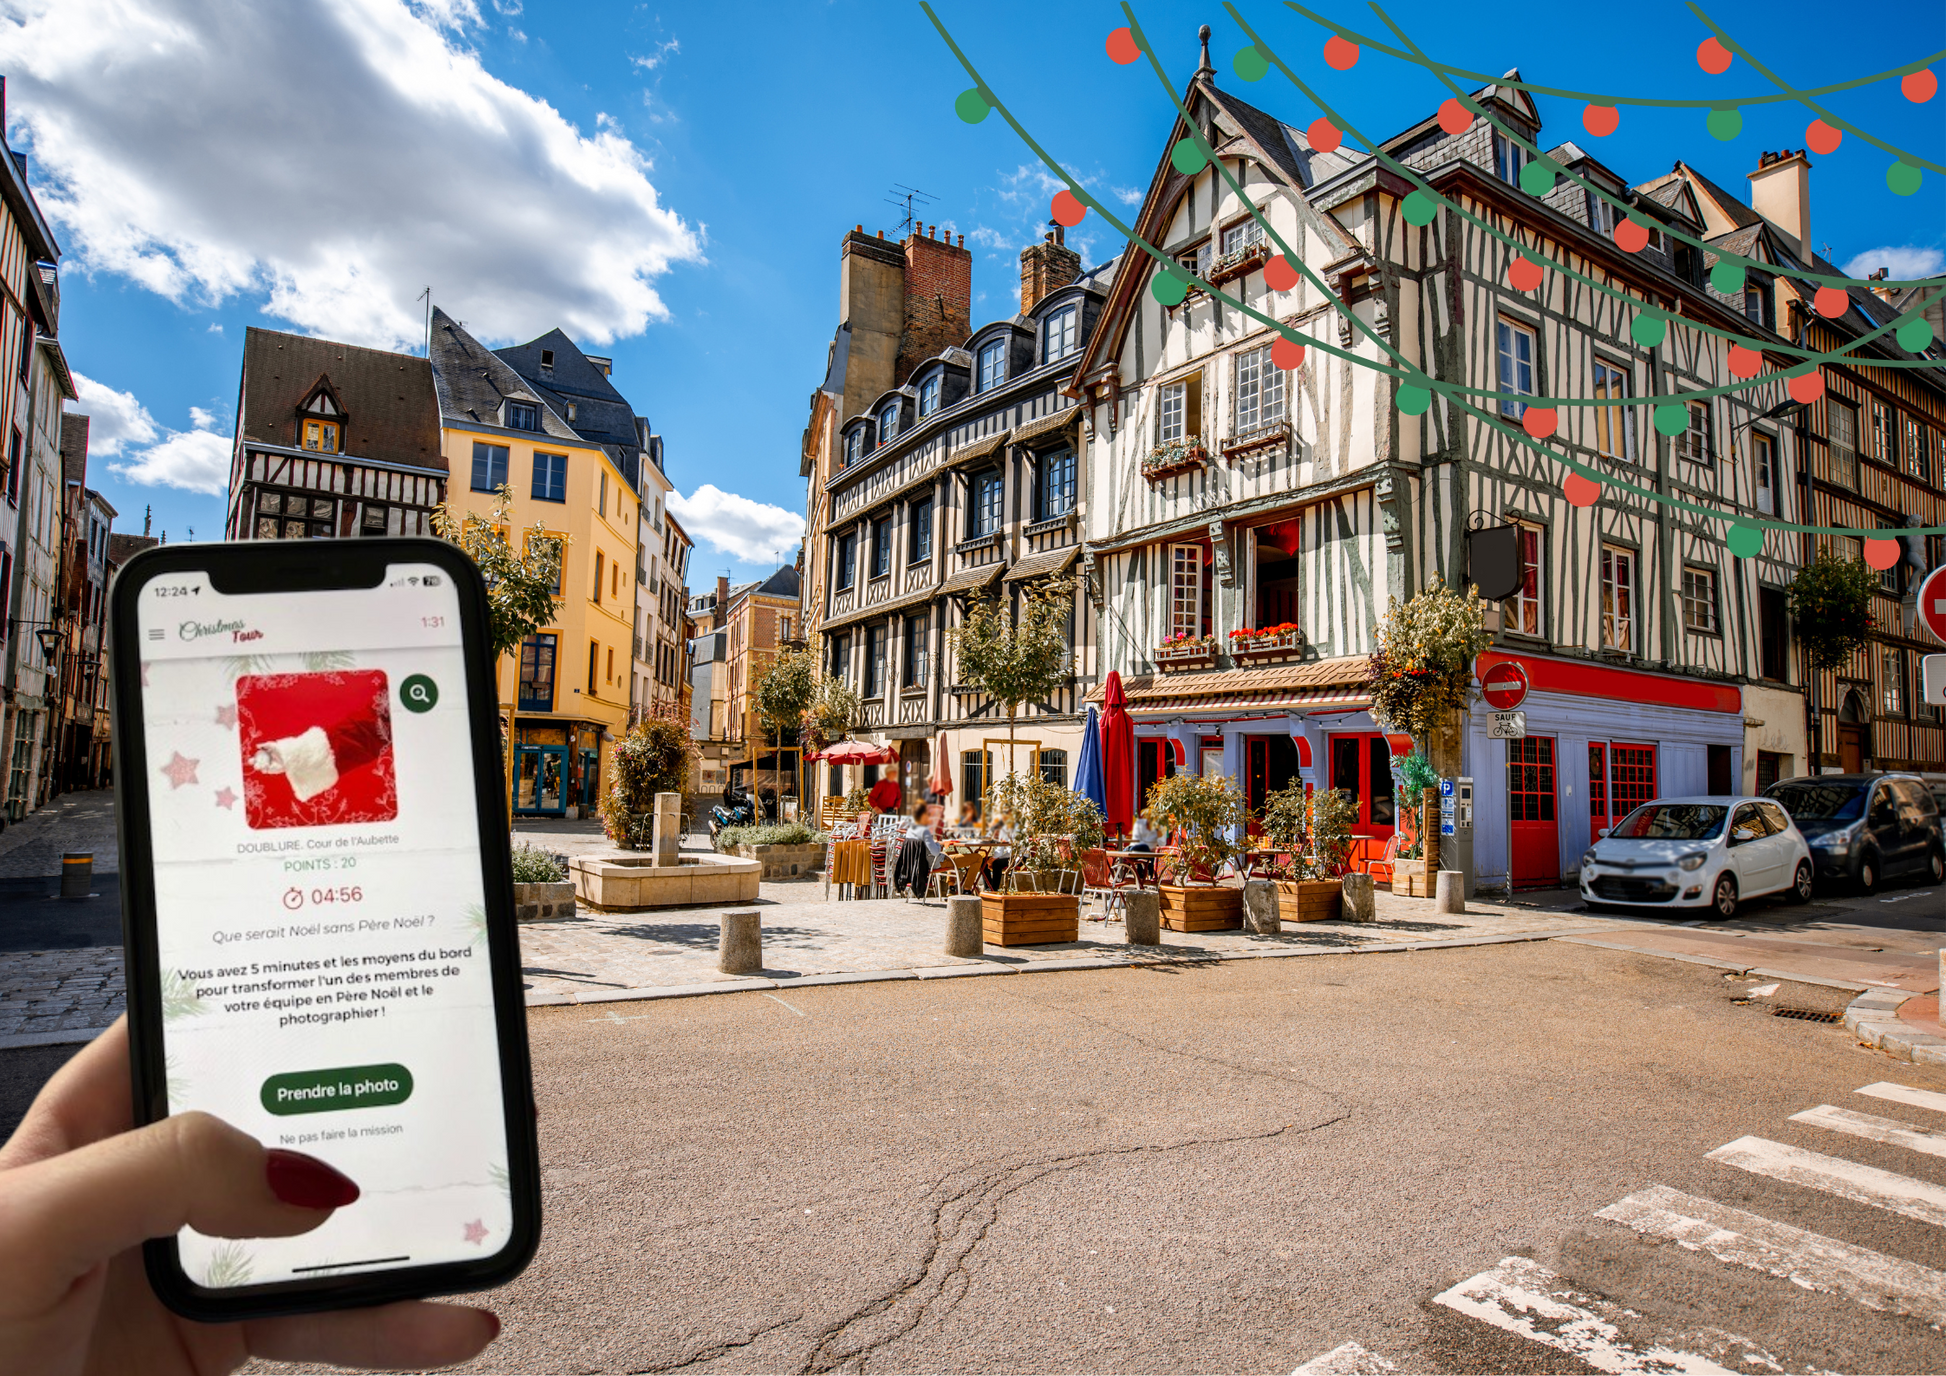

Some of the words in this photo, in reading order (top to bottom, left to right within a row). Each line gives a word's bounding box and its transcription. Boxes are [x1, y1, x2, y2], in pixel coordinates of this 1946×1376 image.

[154, 586, 188, 597] 12:24
[179, 619, 246, 641] Christmas
[421, 617, 445, 627] 1:31
[232, 628, 264, 643] Tour
[1444, 784, 1450, 794] P
[307, 838, 333, 849] Cour
[336, 837, 349, 847] de
[351, 834, 399, 847] l'Aubette
[284, 859, 331, 872] POINTS
[341, 857, 357, 868] 20
[311, 887, 363, 905] 04:56
[213, 930, 242, 945] Que
[245, 927, 285, 942] serait
[289, 922, 321, 938] Noël
[323, 923, 355, 934] sans
[359, 919, 390, 932] Père
[393, 916, 425, 929] Noël
[179, 967, 214, 981] Vous
[217, 966, 247, 978] avez
[251, 963, 260, 975] 5
[263, 960, 320, 974] minutes
[323, 958, 337, 969] et
[340, 956, 359, 968] les
[362, 952, 415, 964] moyens
[418, 950, 436, 962] du
[440, 946, 472, 960] bord
[196, 984, 229, 1000] pour
[232, 979, 315, 994] transformer
[318, 975, 343, 986] l'un
[346, 973, 371, 984] des
[374, 969, 438, 981] membres
[442, 965, 460, 977] de
[224, 1000, 260, 1013] votre
[263, 995, 312, 1009] équipe
[316, 995, 333, 1005] en
[336, 990, 368, 1003] Père
[371, 985, 402, 1000] Noël
[405, 986, 418, 998] et
[421, 984, 434, 996] le
[279, 1007, 379, 1028] photographier
[277, 1084, 336, 1102] Prendre
[339, 1082, 352, 1096] la
[354, 1078, 399, 1097] photo
[280, 1134, 296, 1145] Ne
[299, 1132, 319, 1145] pas
[321, 1129, 346, 1141] faire
[348, 1127, 358, 1138] la
[360, 1124, 404, 1136] mission
